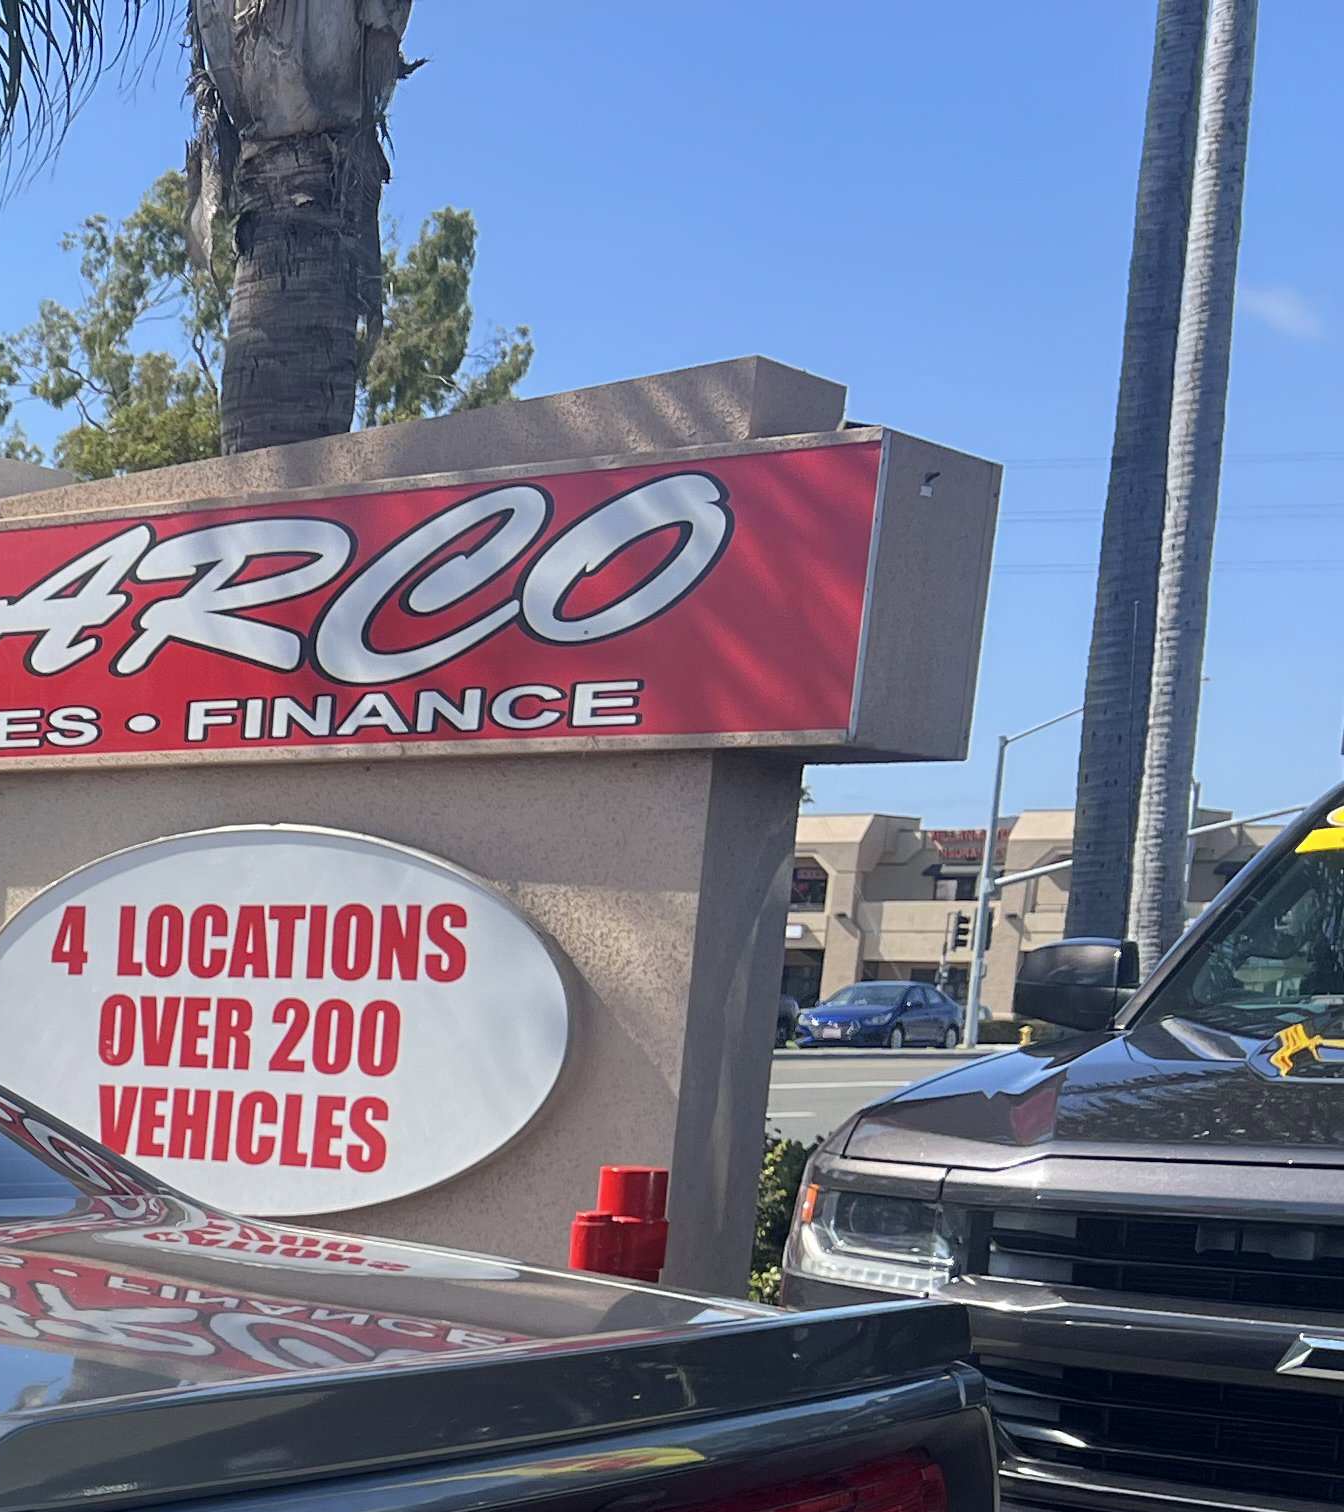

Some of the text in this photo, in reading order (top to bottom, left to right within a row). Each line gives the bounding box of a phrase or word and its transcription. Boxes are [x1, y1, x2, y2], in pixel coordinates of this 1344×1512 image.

[185, 679, 642, 742] FINANCE
[51, 903, 468, 983] 4 LOCATIONS
[98, 994, 401, 1077] OVER 200
[98, 1084, 389, 1173] VEHICLES
